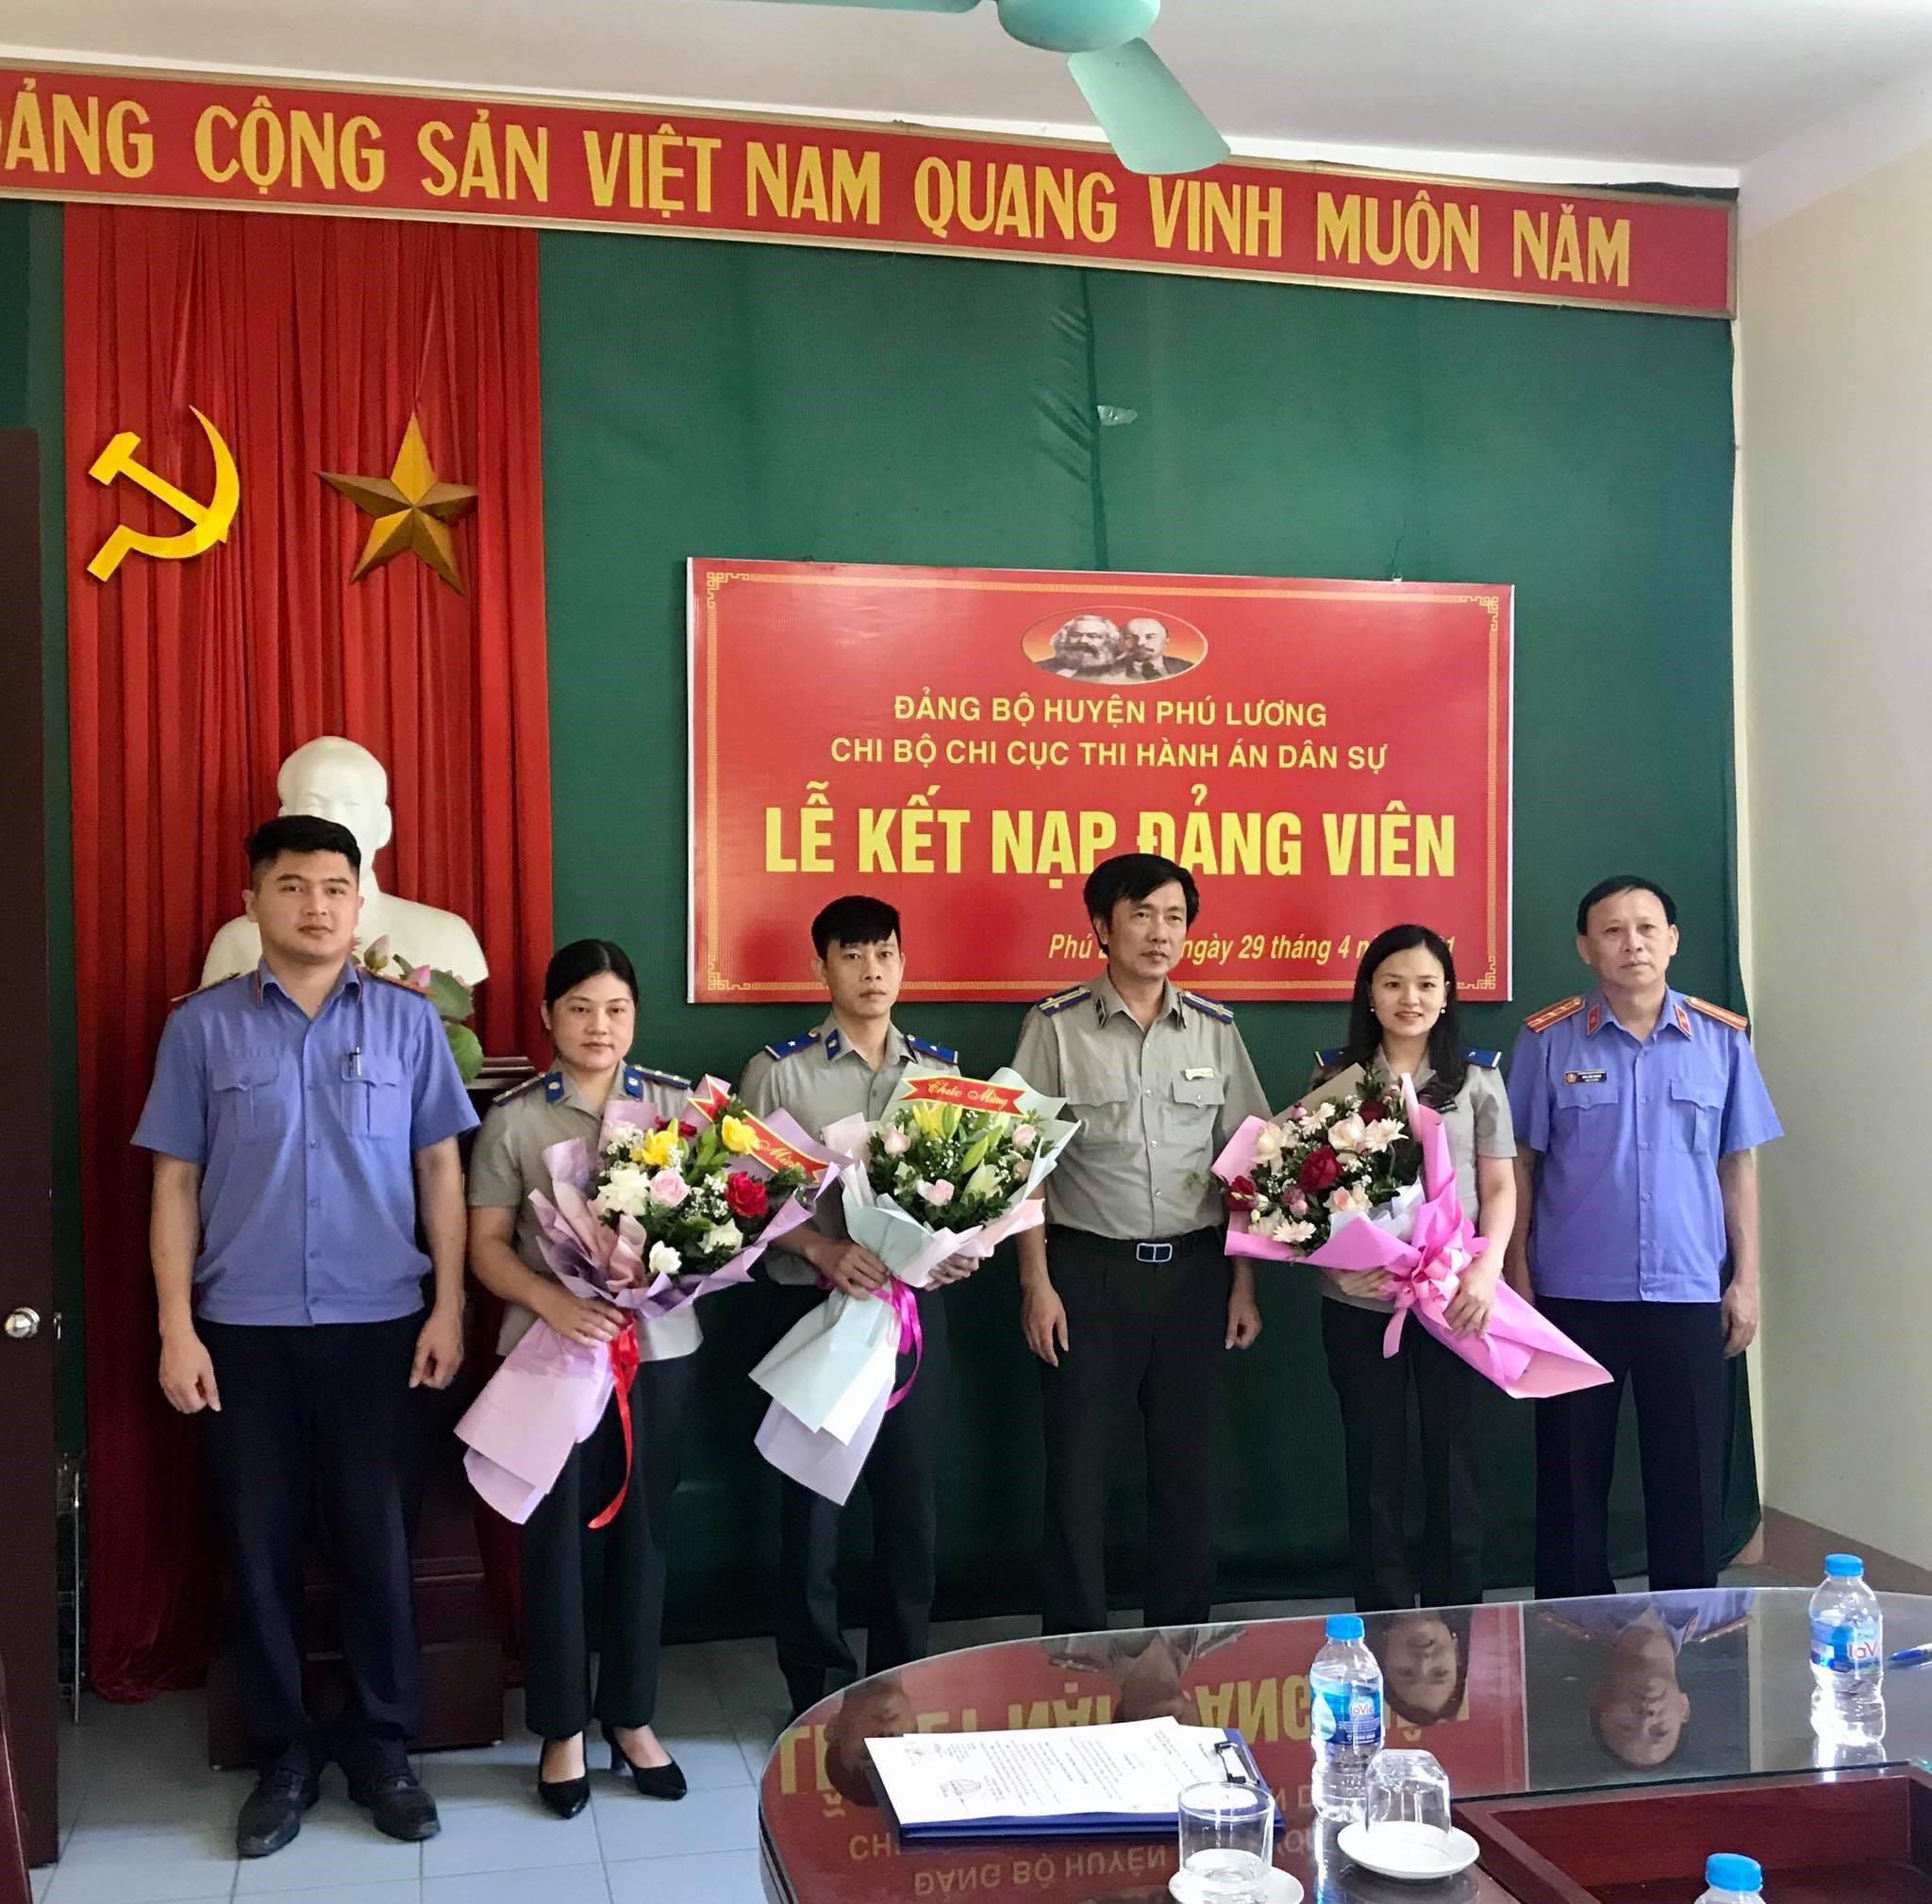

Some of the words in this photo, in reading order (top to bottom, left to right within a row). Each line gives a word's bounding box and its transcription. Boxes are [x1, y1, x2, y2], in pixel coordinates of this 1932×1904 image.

[0, 77, 154, 178] ẢNG
[194, 94, 386, 195] CỘNG
[417, 109, 548, 202] SẢN
[583, 123, 722, 218] VIỆT
[746, 142, 881, 225] NAM
[913, 156, 1118, 242] QUANG
[1148, 175, 1282, 258] VINH
[1316, 189, 1479, 274] MUÔN
[1513, 203, 1630, 287] NĂM
[894, 687, 980, 722] ĐẢNG
[992, 691, 1035, 727] BỘ
[1045, 694, 1145, 728] HUYỆN
[1157, 695, 1216, 726] PHÚ
[1227, 699, 1326, 727] LƯƠNG
[831, 738, 883, 762] CHI
[893, 733, 937, 769] BỘ
[946, 740, 997, 765] CHI
[1007, 741, 1070, 771] CỤC
[1079, 743, 1126, 766] THI
[1138, 738, 1218, 767] HÀNH
[1229, 738, 1268, 768] ÁN
[1279, 740, 1338, 769] DÂN
[1348, 743, 1389, 774] SỰ
[765, 780, 835, 873] LỄ
[859, 785, 971, 874] KẾT
[992, 810, 1117, 890] NẠP
[1136, 783, 1302, 877] ĐẢNG
[1323, 800, 1455, 877] VIÊN
[1048, 934, 1092, 960] Phú
[1180, 934, 1233, 966] ngày
[1238, 934, 1265, 960] 29
[1271, 935, 1332, 965] tháng
[1338, 935, 1351, 958] 4
